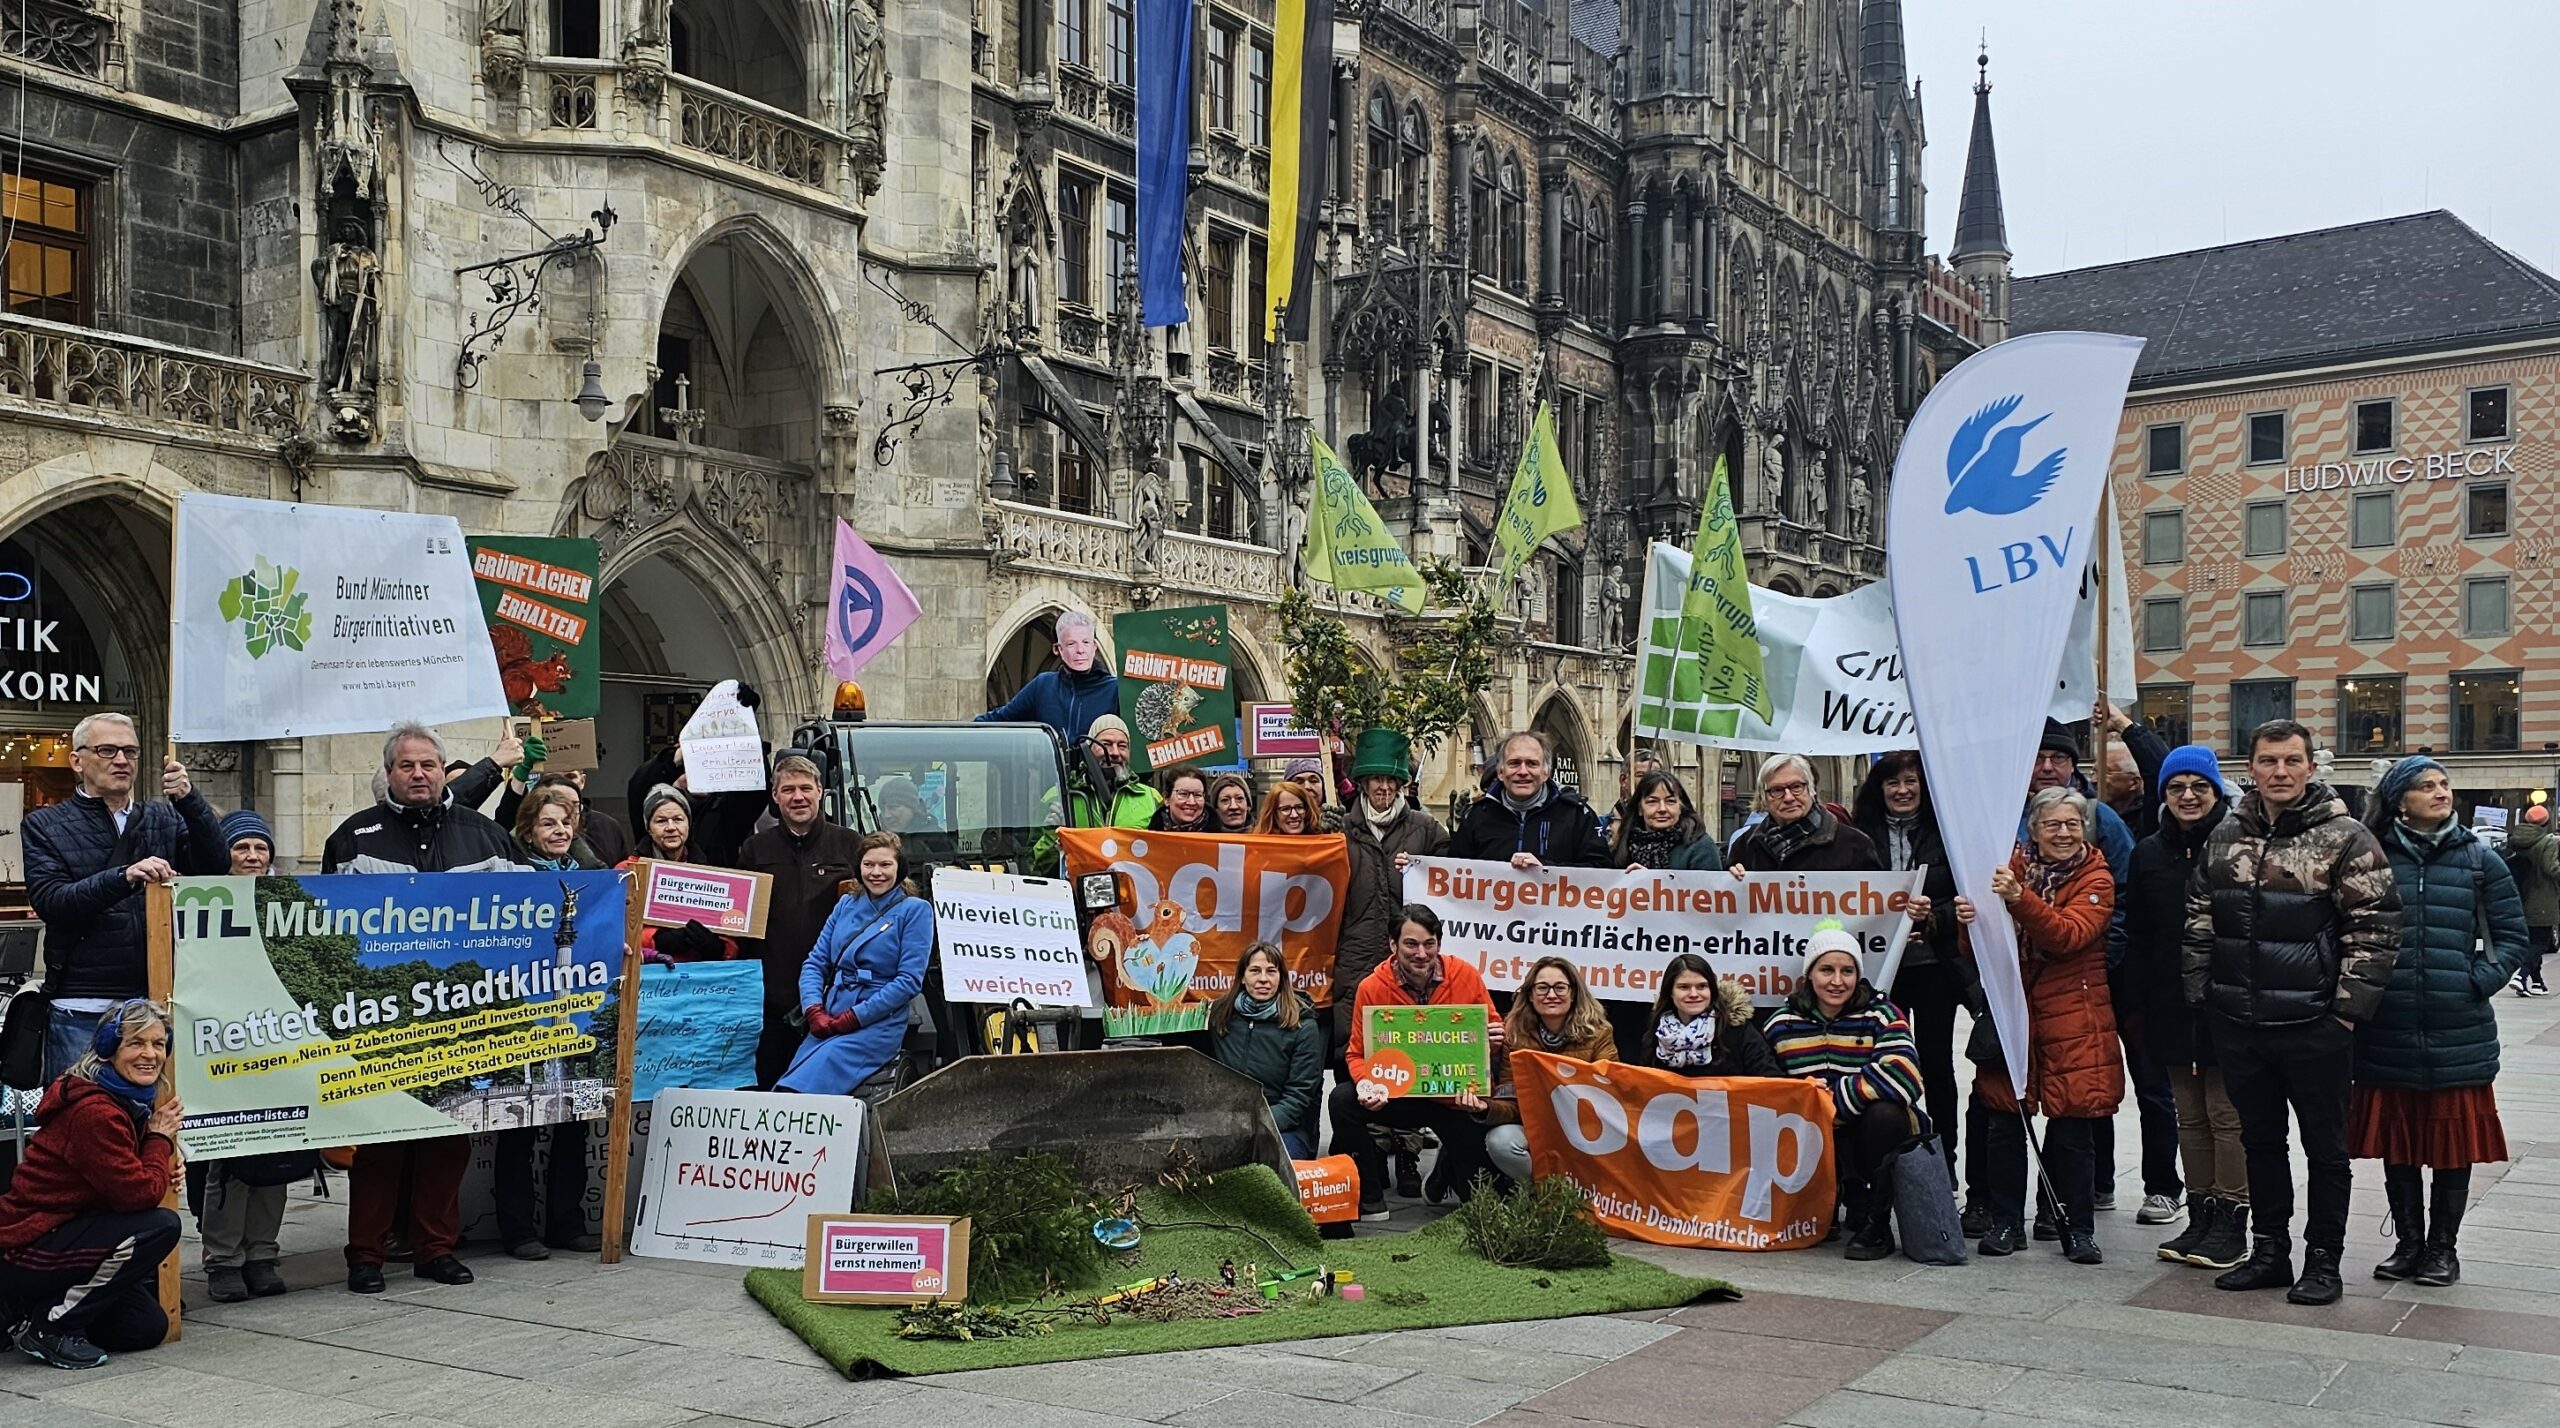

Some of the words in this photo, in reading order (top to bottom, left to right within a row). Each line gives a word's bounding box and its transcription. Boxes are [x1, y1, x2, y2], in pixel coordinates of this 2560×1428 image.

[2285, 457, 2415, 493] LUDWIG
[2426, 445, 2516, 480] BECK
[1964, 526, 2073, 594] LBV
[336, 575, 368, 600] Bund
[370, 577, 430, 600] Münchner
[474, 553, 592, 600] GRÜNFLÄCHEN
[334, 614, 456, 643] Bürgerinitiativen
[497, 593, 581, 643] ERHALTEN.
[311, 660, 345, 670] Gemeinsam
[356, 658, 367, 669] ein
[368, 656, 422, 669] lebenswertes
[423, 654, 464, 666] München
[1125, 653, 1227, 687] GRÜNFLÄCHEN
[1836, 644, 1904, 682] Grü
[341, 679, 416, 690] www.bmbi.bayern
[1147, 731, 1223, 767] ERHALTEN.
[660, 877, 725, 895] Bürgerwillen
[1427, 867, 1737, 920] Bürgerbegehren
[1749, 880, 1911, 915] Münche
[265, 894, 555, 937] München-Liste
[658, 893, 684, 904] ernst
[686, 897, 730, 910] nehmen!
[935, 901, 1020, 926] Wieviel
[1023, 909, 1076, 931] Grün
[365, 936, 451, 954] überparteilich
[462, 934, 532, 949] unabhängig
[953, 942, 1016, 960] muss
[1024, 947, 1079, 964] noch
[692, 986, 737, 995] unsere
[965, 976, 1073, 997] weichen?
[194, 1002, 321, 1056] Rettet
[332, 992, 399, 1030] das
[412, 959, 608, 1017] Stadtklima
[210, 1062, 238, 1077] Wir
[243, 1055, 288, 1072] sagen
[292, 1045, 331, 1064] „Nein
[335, 1043, 351, 1054] zu
[355, 1022, 456, 1049] Zubetonierung
[460, 1014, 487, 1030] und
[1377, 1031, 1401, 1044] WIR
[1408, 1031, 1478, 1044] BRAUCHEN
[320, 1069, 357, 1084] Denn
[359, 1056, 423, 1077] München
[427, 1050, 443, 1063] ist
[447, 1042, 485, 1058] schon
[489, 1036, 526, 1051] heute
[530, 1029, 549, 1041] die
[553, 1027, 574, 1038] am
[321, 1080, 386, 1103] stärksten
[390, 1064, 464, 1088] versiegelte
[467, 1055, 503, 1072] Stadt
[506, 1039, 592, 1063] Deutschlands
[1371, 1063, 1410, 1086] ödp
[1421, 1063, 1477, 1077] BÄUME
[671, 1105, 842, 1136] GRÜNFLÄCHEN-
[708, 1136, 803, 1164] BILANZ-
[1551, 1061, 1823, 1222] ödp
[678, 1162, 816, 1196] FÄLSCHUNG
[1312, 1176, 1351, 1198] Bienen!
[835, 1239, 914, 1254] Bürgerwillen
[834, 1258, 866, 1269] ernst
[868, 1258, 922, 1270] nehmen!
